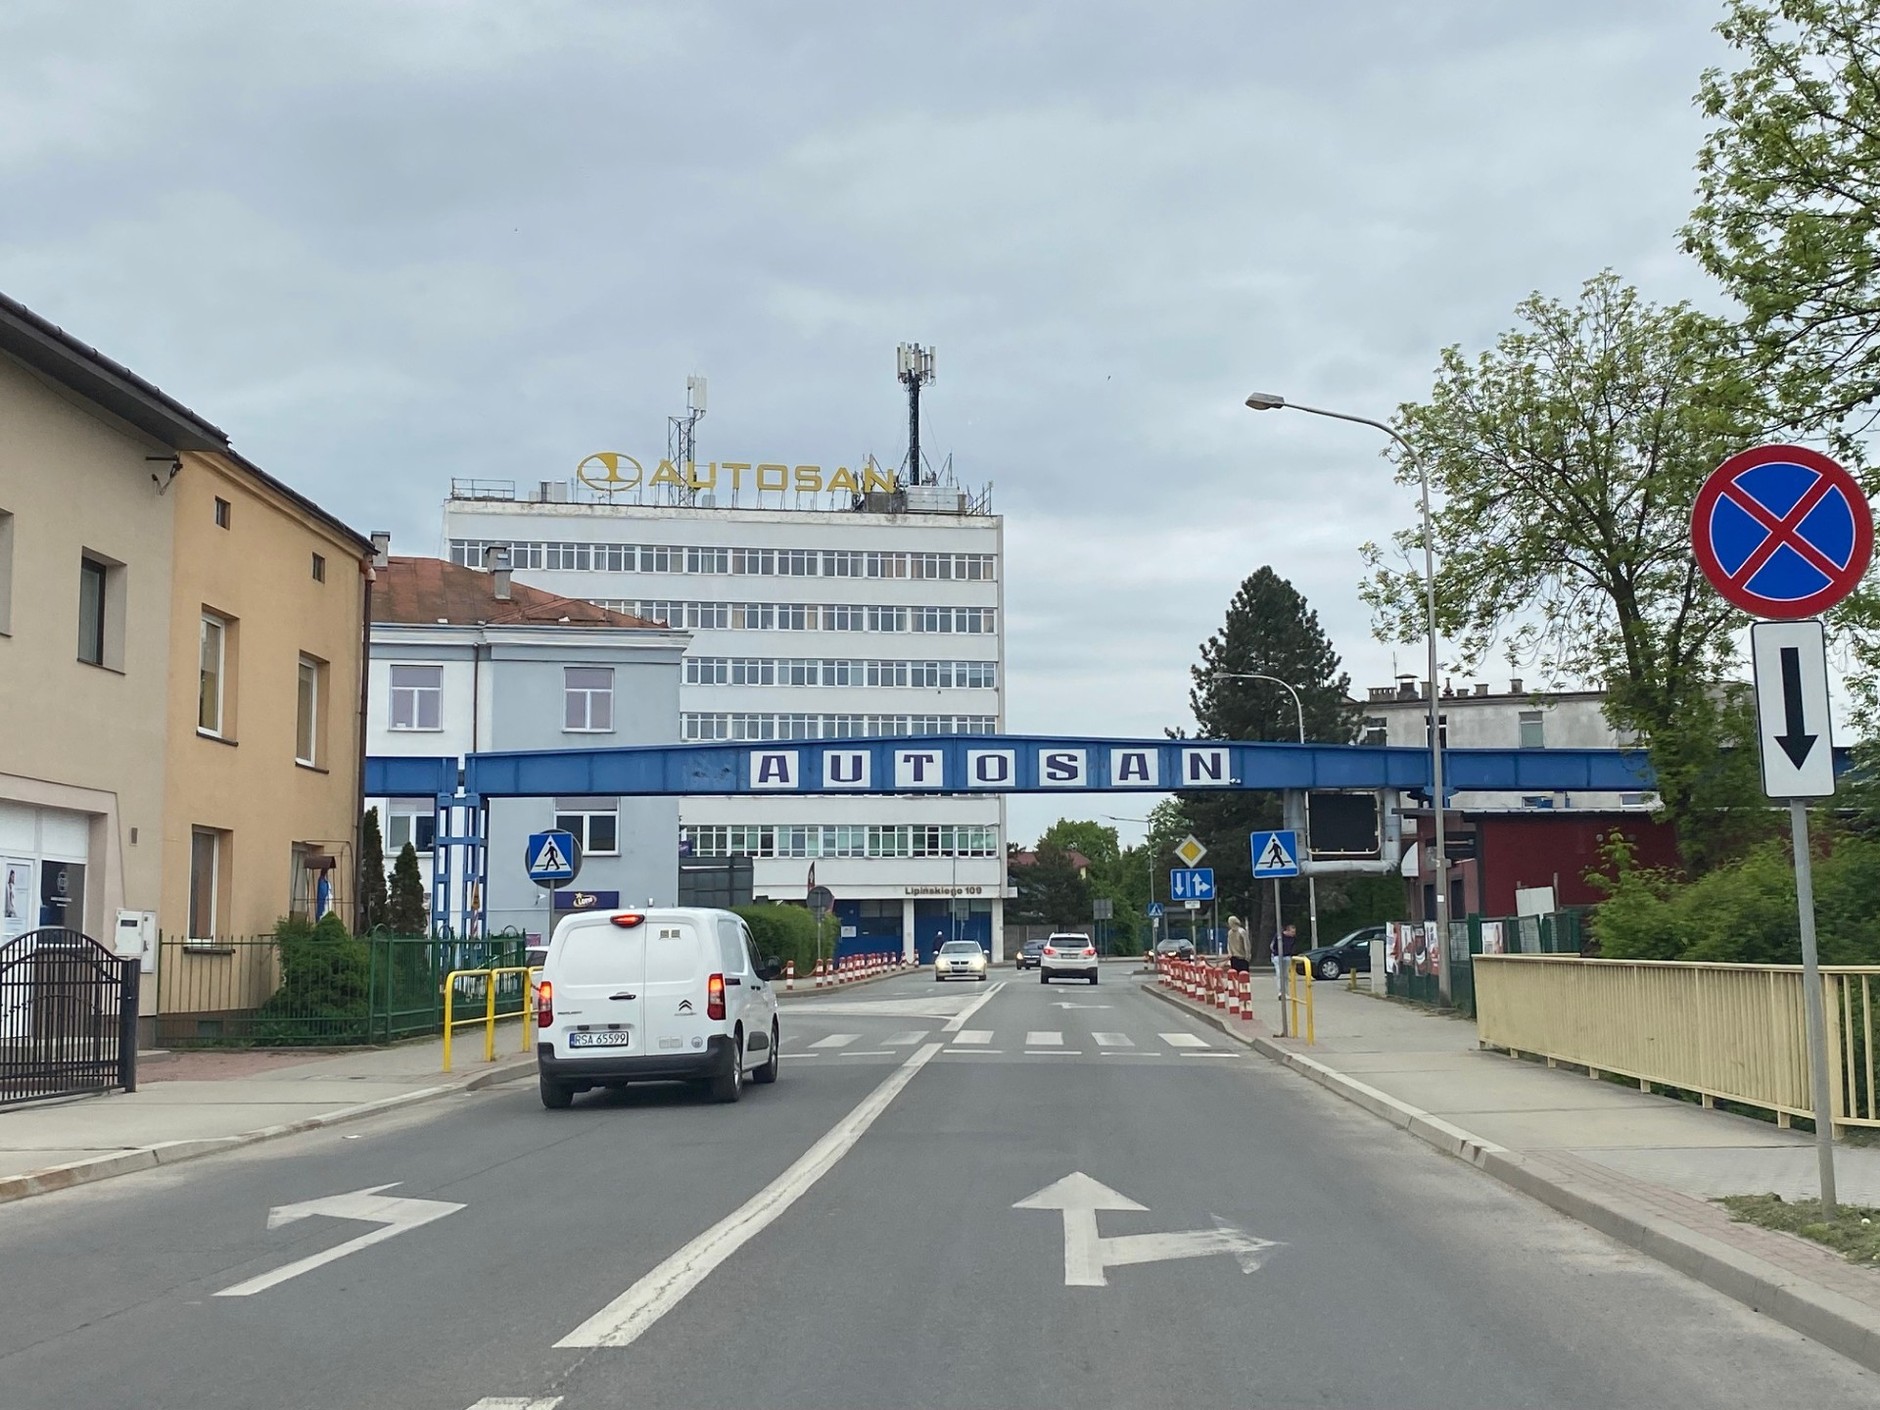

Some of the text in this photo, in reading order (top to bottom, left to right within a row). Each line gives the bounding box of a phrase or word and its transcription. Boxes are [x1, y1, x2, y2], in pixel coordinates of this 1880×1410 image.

[648, 458, 895, 494] AUTOSAN
[758, 752, 1223, 783] AUTOSAN
[905, 886, 982, 897] Lipińskiego 109
[575, 1033, 626, 1045] RSA 65599
